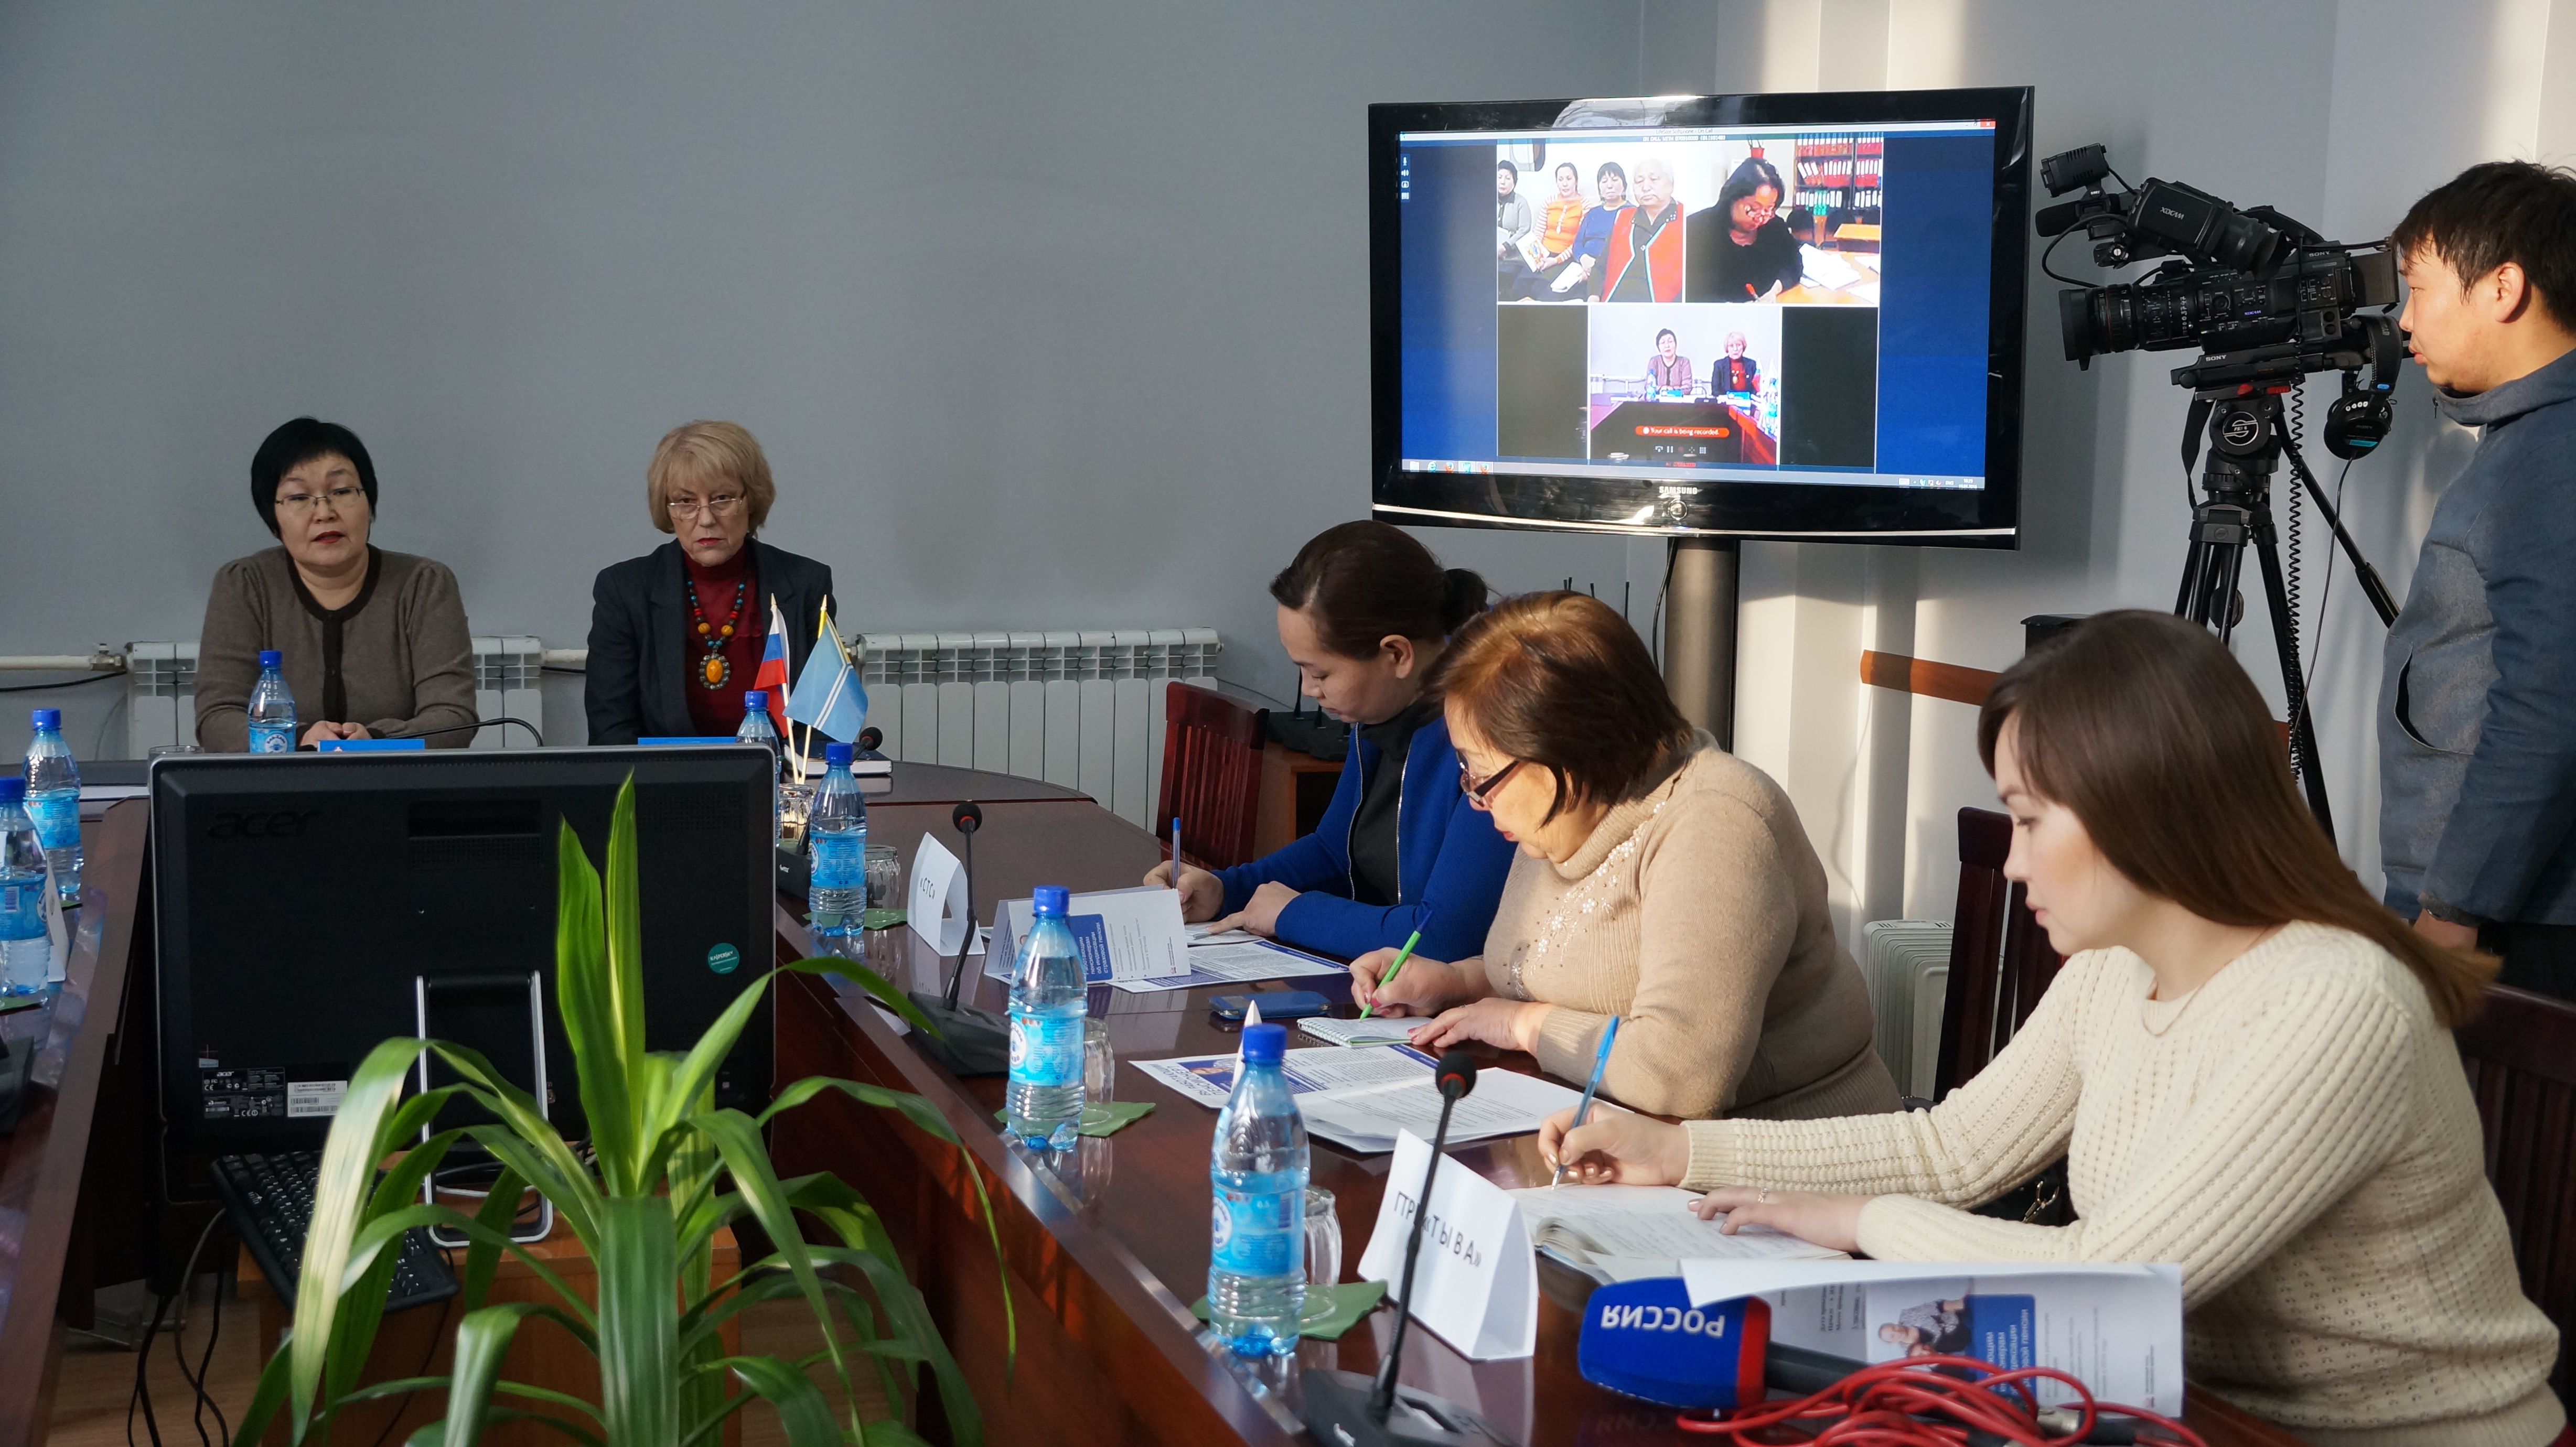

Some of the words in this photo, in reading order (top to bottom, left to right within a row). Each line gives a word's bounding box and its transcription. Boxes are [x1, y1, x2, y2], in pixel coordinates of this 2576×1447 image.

[2160, 206, 2185, 221] XDCAM
[1659, 485, 1698, 494] SAMSUNG
[208, 809, 323, 838] acer
[1095, 921, 1103, 943] пенсии
[1085, 936, 1096, 975] пенсионерам
[1091, 931, 1101, 966] индексации
[1098, 944, 1109, 974] страховой
[1094, 966, 1102, 974] об
[1601, 1304, 1726, 1338] РОССИЯ
